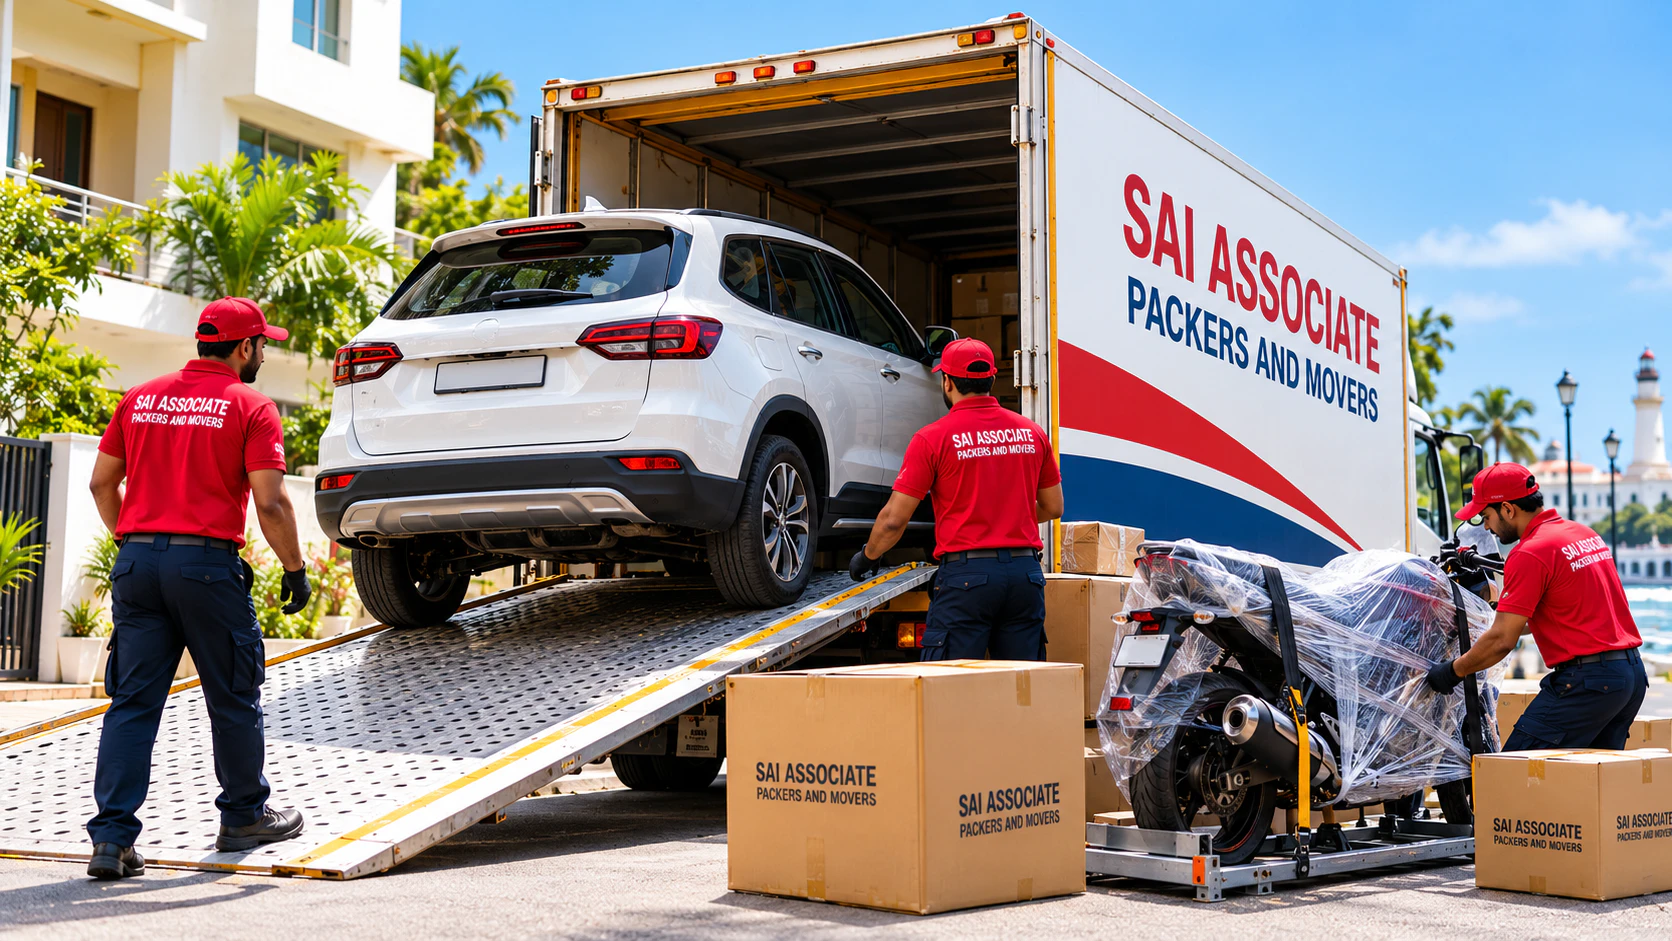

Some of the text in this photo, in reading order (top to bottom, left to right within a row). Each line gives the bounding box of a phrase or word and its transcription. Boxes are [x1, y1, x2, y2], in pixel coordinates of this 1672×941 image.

[1123, 173, 1380, 375] SAI ASSOCIATE
[1127, 275, 1379, 423] PACKERS AND MOVERS
[134, 394, 231, 416] SAI ASSOCIATE
[131, 412, 224, 429] PACKERS AND MOVERS
[952, 428, 1035, 448] SAI ASSOCIATE
[957, 446, 991, 460] PACKERS
[992, 445, 1008, 456] AND
[756, 761, 877, 787] SAI ASSOCIATE
[756, 786, 877, 806] PACKERS AND MOVERS
[958, 782, 1060, 817] SAI ASSOCIATE
[959, 809, 1060, 838] PACKERS AND MOVERS
[1493, 817, 1582, 840] SAI ASSOCIATE
[1616, 815, 1630, 830] SAI
[1494, 834, 1582, 853] PACKERS AND MOVERS
